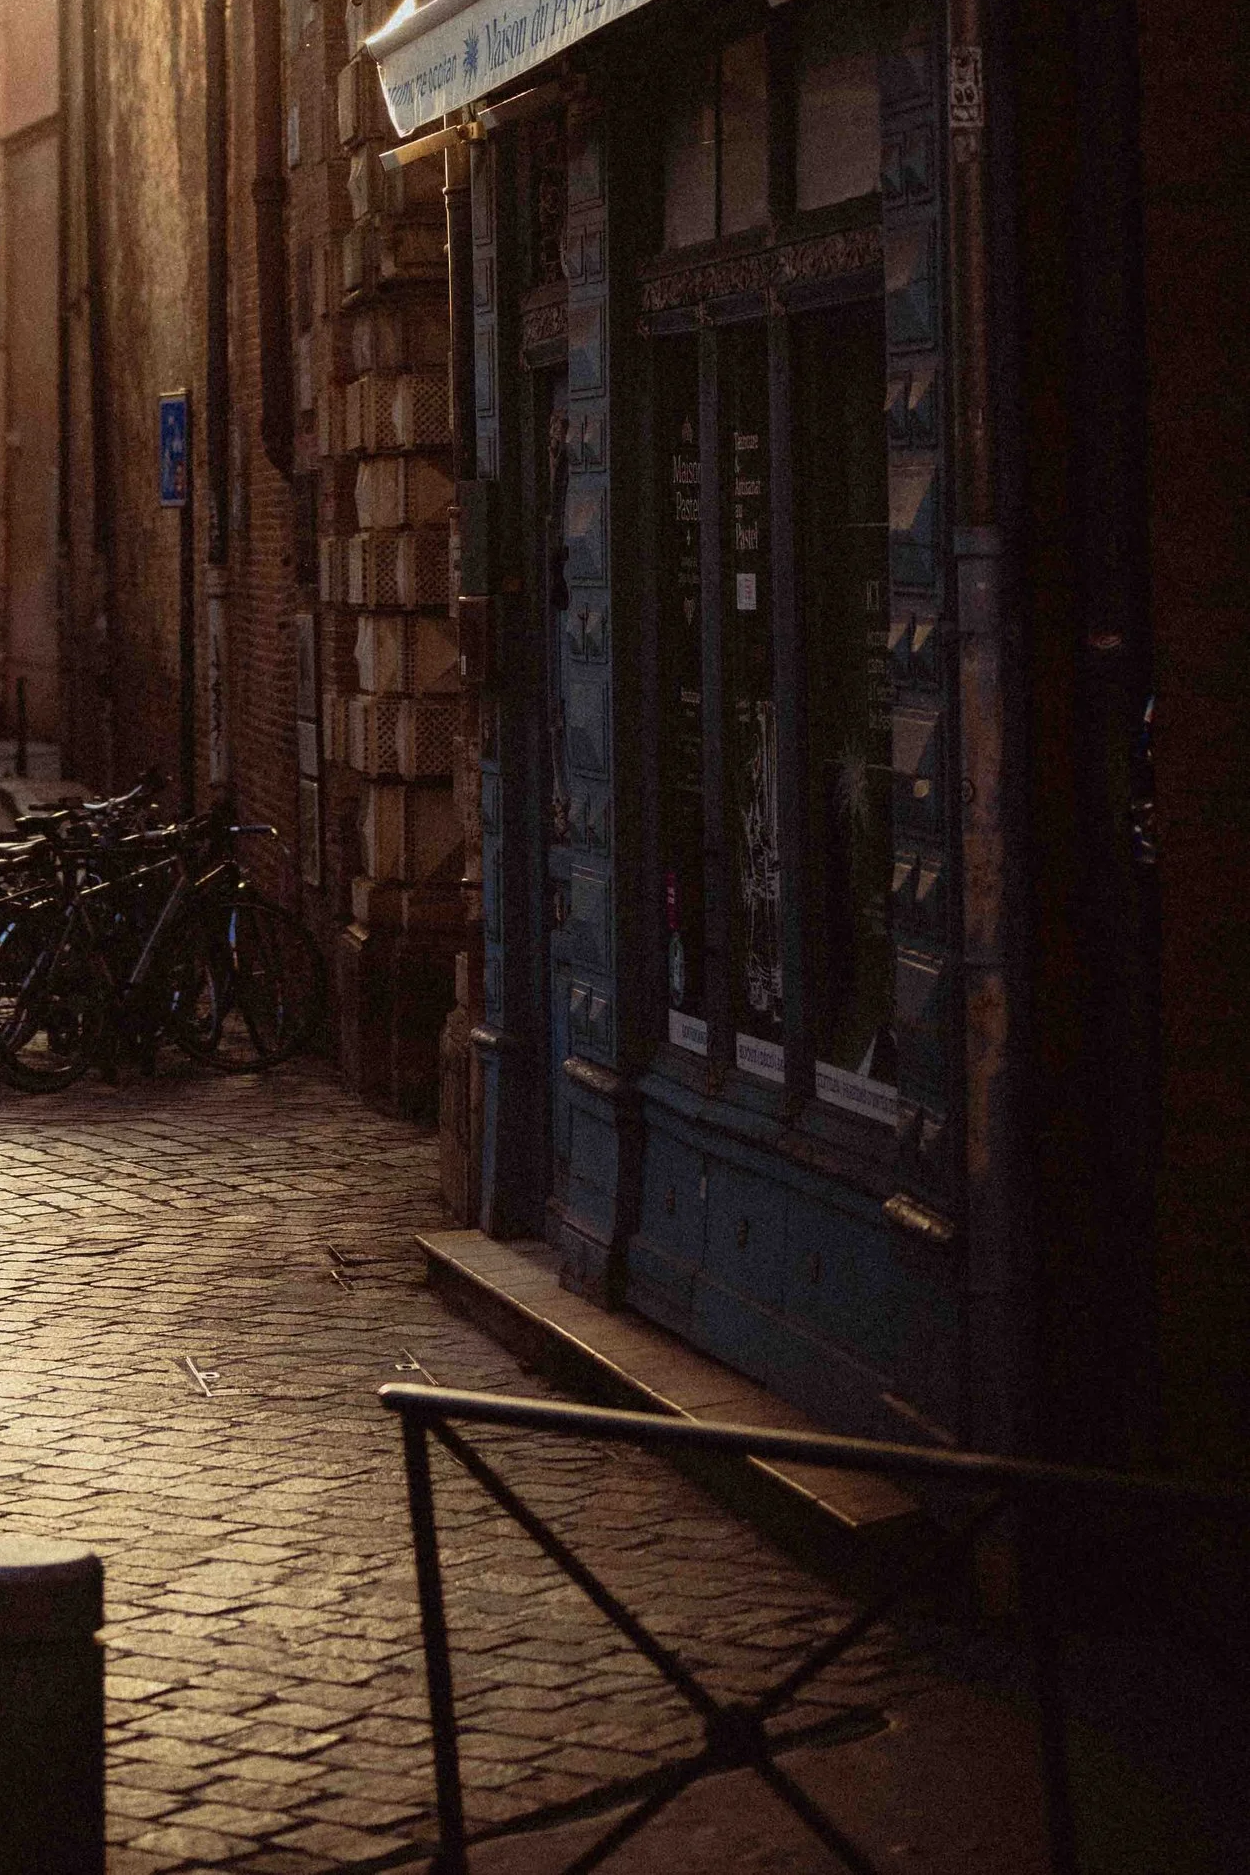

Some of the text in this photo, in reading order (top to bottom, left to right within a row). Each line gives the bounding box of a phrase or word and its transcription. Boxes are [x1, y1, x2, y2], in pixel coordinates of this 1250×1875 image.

[486, 12, 527, 70] Maison
[675, 491, 701, 521] Paste
[735, 521, 759, 550] Pastel
